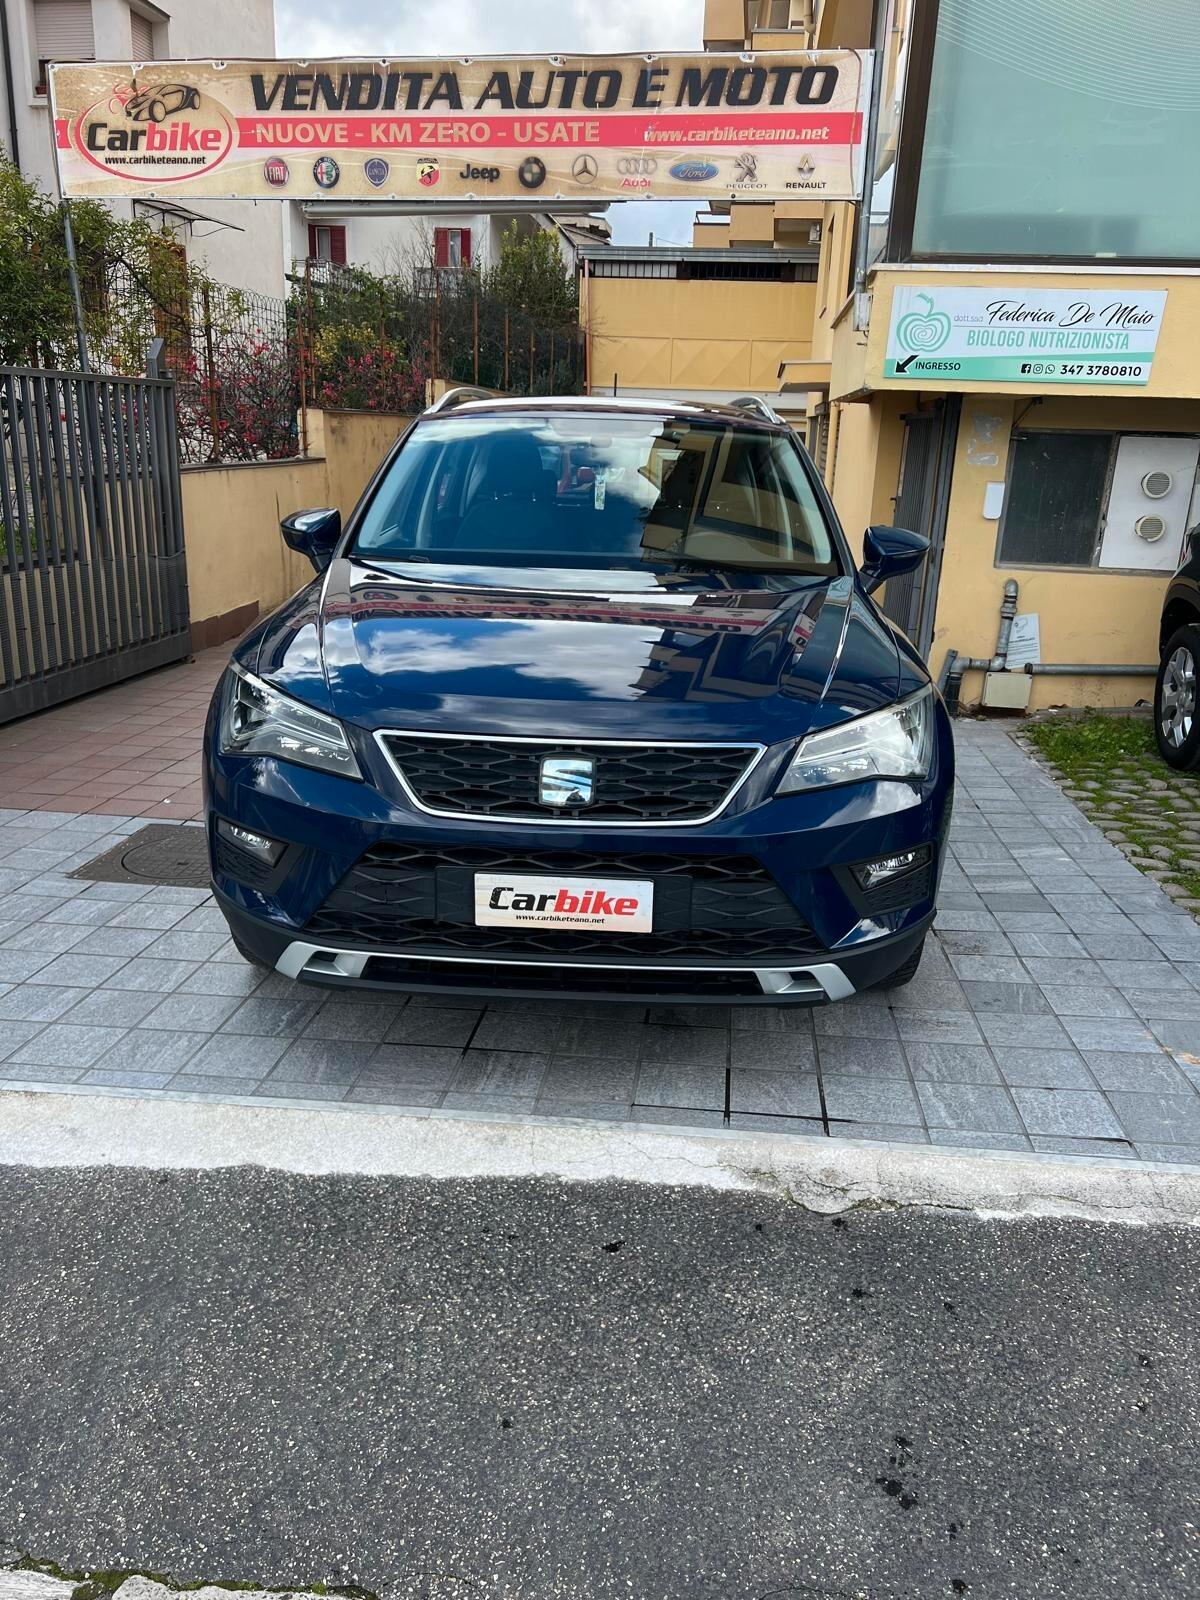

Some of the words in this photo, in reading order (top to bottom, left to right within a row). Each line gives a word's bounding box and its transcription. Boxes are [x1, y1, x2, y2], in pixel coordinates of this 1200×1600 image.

[250, 73, 463, 111] VENDITA
[474, 70, 622, 109] AUTO
[632, 70, 667, 108] E
[675, 65, 839, 107] MOTO
[86, 121, 221, 151] Carbike
[256, 124, 348, 143] NUOVE
[370, 123, 412, 143] KM
[419, 122, 492, 143] ZERO
[513, 119, 600, 142] USATE
[644, 126, 830, 143] www.carbiketeano.net
[104, 155, 207, 166] www.carbiketeano.net
[268, 166, 285, 181] FIAT
[459, 164, 501, 182] Jeep
[679, 167, 709, 178] Ford
[621, 178, 652, 188] Audi
[985, 299, 1056, 326] Federica
[1058, 301, 1095, 327] De
[1099, 302, 1157, 328] Maio
[966, 329, 1025, 348] BIOLOGO
[1028, 330, 1130, 350] NUTRIZIONISTA
[914, 361, 962, 371] INGRESSO
[1059, 364, 1084, 375] 347
[1086, 364, 1142, 377] 3780810
[488, 886, 639, 916] Carbike
[515, 915, 606, 924] www.carbiketeano.net
